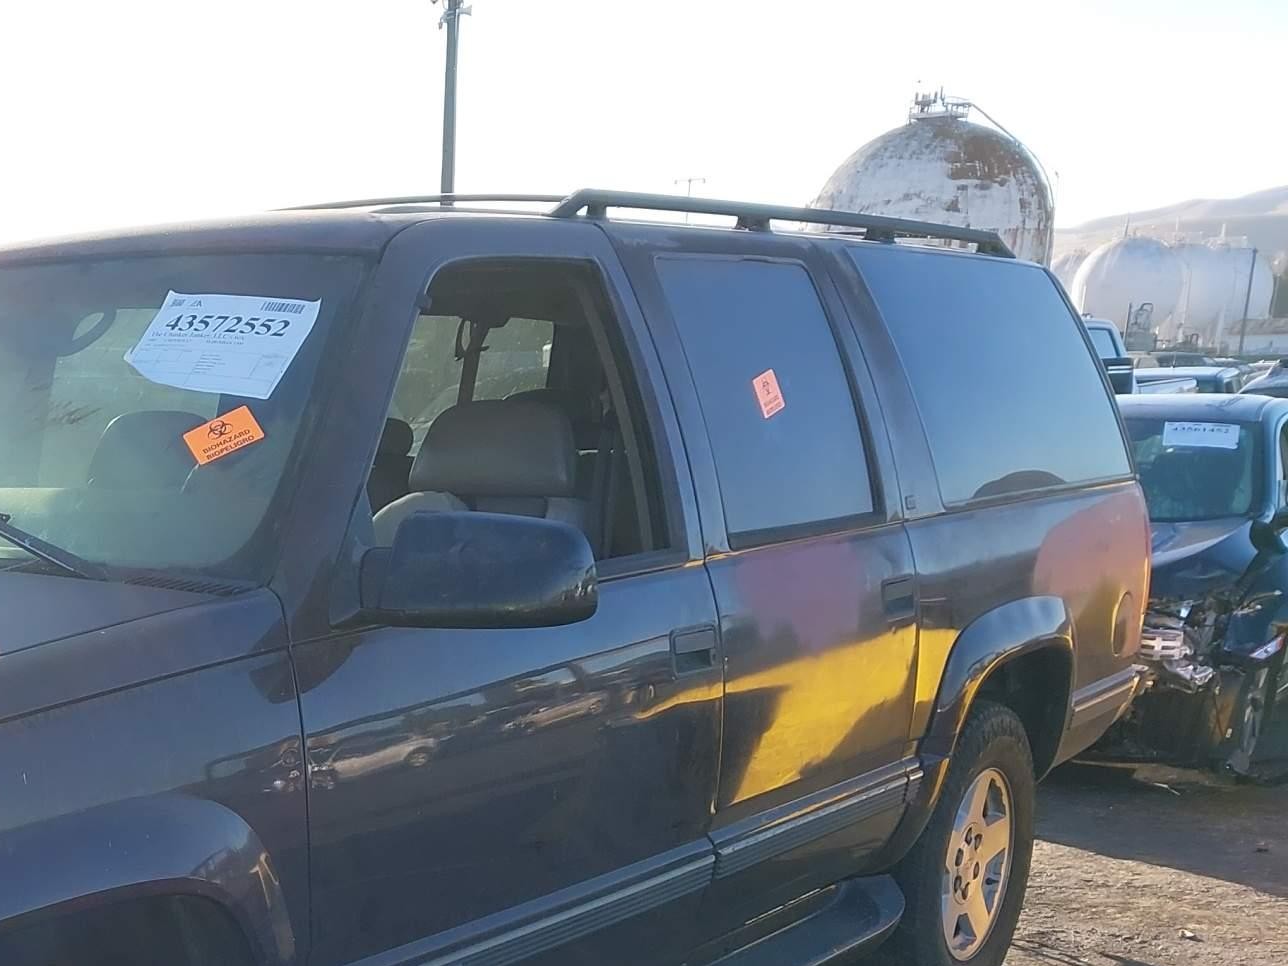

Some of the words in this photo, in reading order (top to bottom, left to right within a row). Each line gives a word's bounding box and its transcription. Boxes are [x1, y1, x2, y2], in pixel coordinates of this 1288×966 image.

[165, 313, 290, 338] 43572552
[202, 429, 250, 454] BIOHAZARD
[206, 435, 254, 460] BIOPELIGRO
